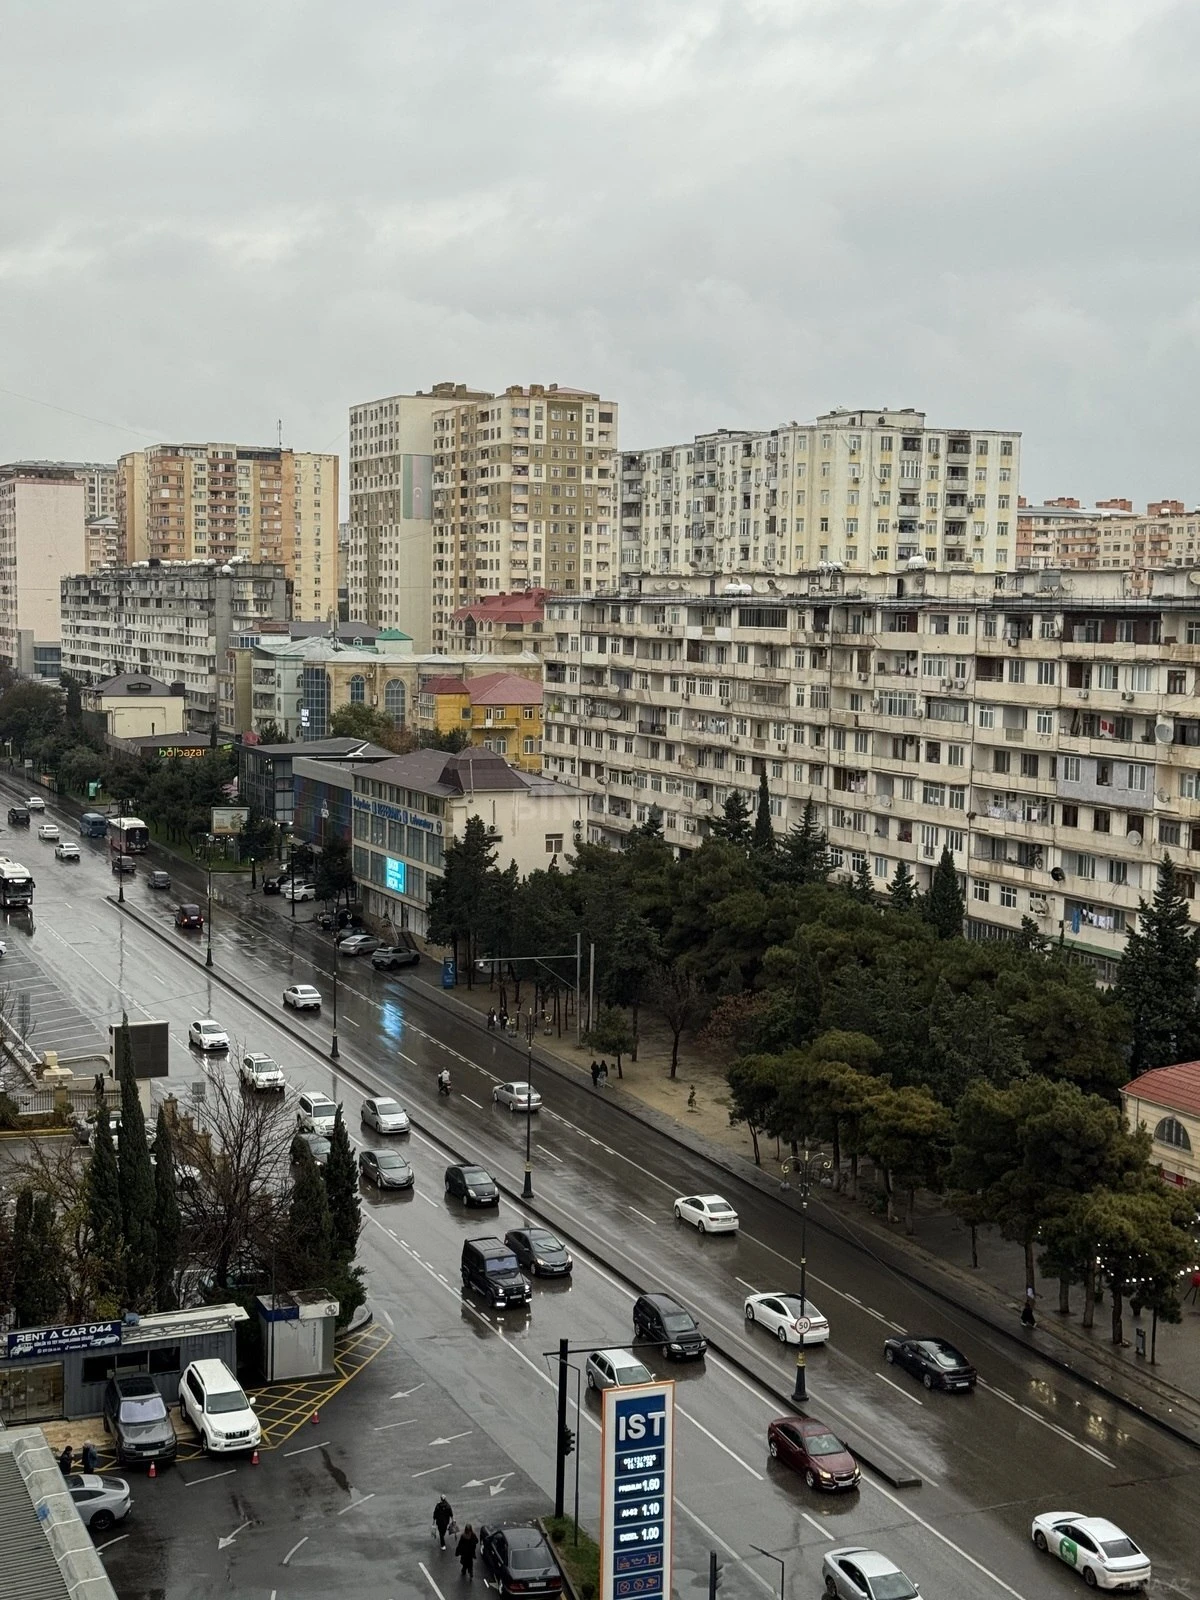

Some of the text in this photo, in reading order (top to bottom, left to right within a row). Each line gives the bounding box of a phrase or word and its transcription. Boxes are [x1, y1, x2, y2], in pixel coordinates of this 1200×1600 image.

[798, 1321, 809, 1330] 50
[17, 1324, 112, 1343] RENT A CAR 044
[619, 1411, 665, 1441] IST
[642, 1478, 660, 1491] 1.60
[641, 1502, 660, 1516] 1.10
[641, 1527, 659, 1540] 1.00
